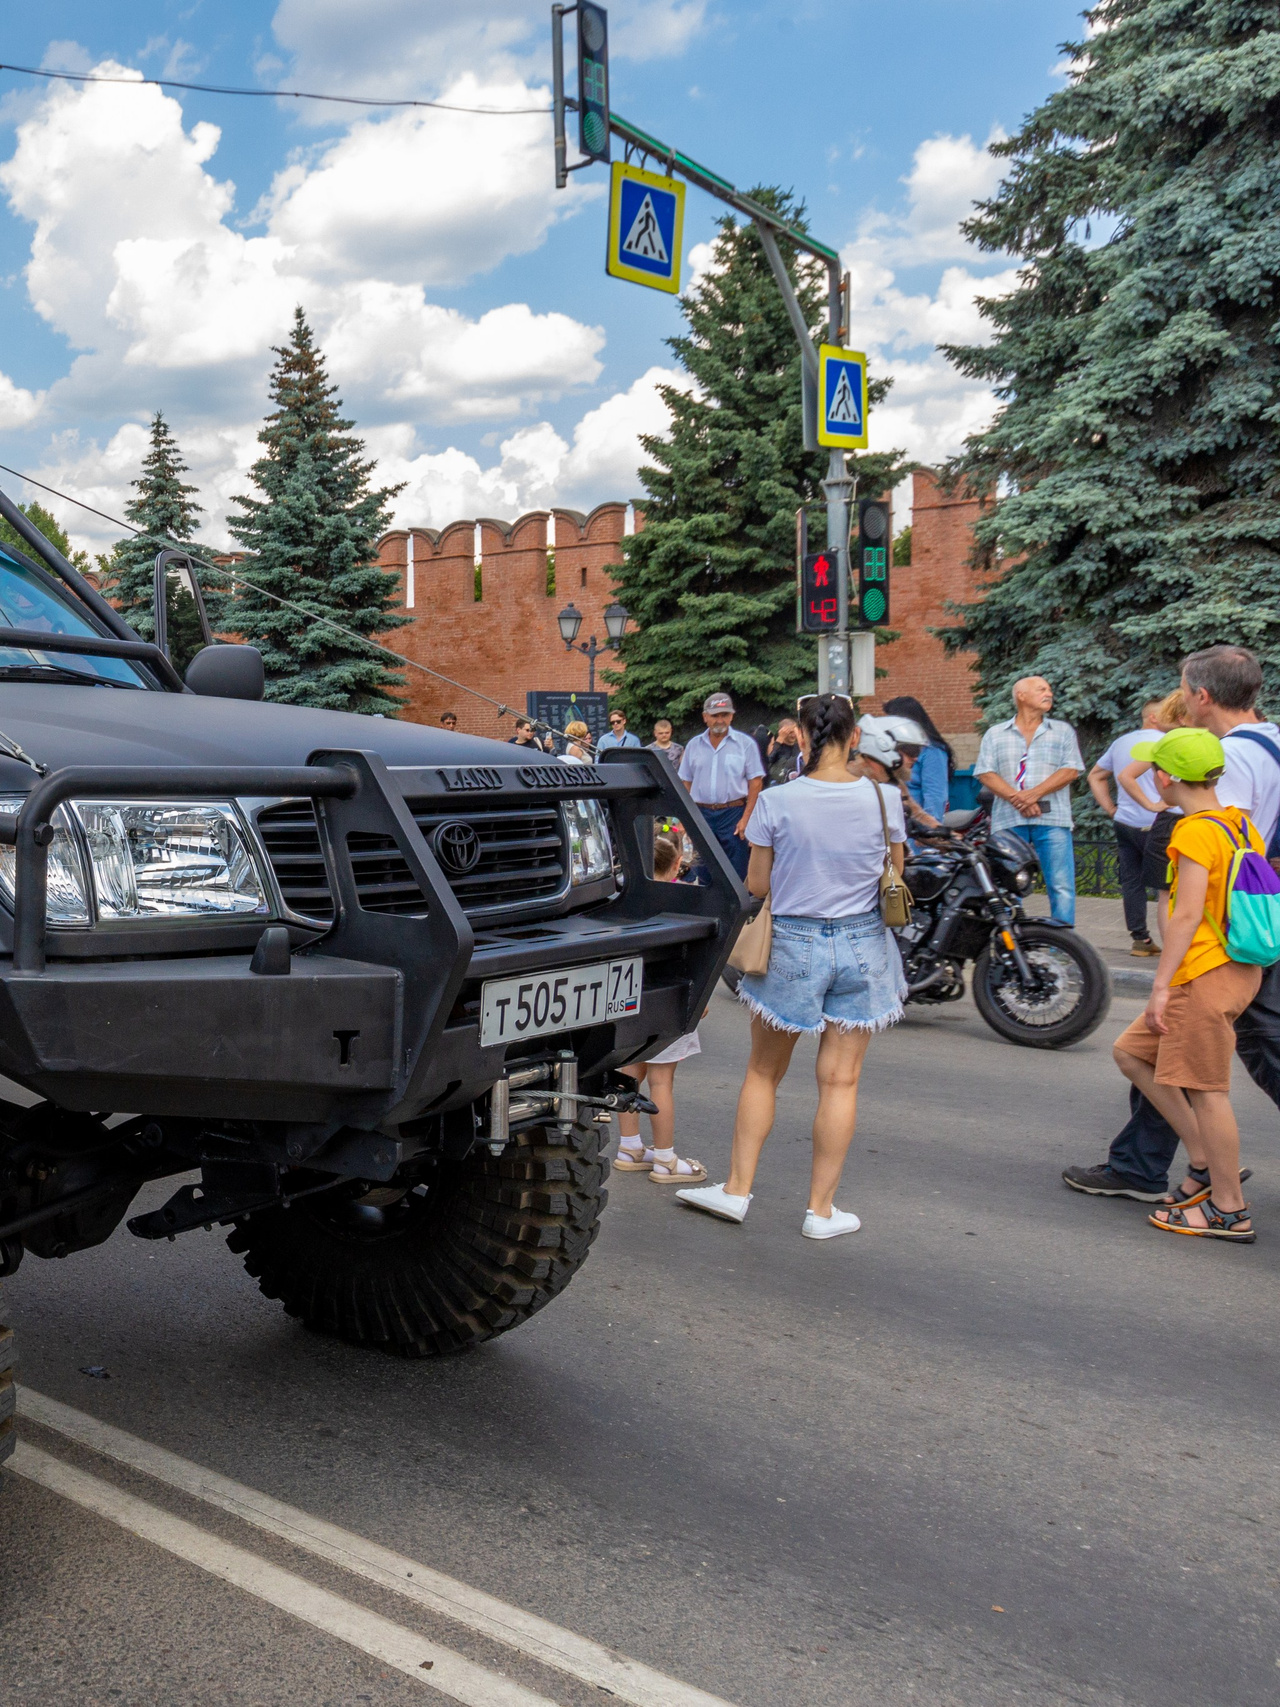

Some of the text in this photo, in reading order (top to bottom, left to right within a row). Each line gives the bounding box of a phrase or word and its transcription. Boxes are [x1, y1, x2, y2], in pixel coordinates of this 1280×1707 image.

[811, 598, 837, 622] 42
[436, 765, 608, 791] LAND CRUISER
[496, 963, 634, 1036] T505TT 71
[607, 1000, 625, 1014] RUS
